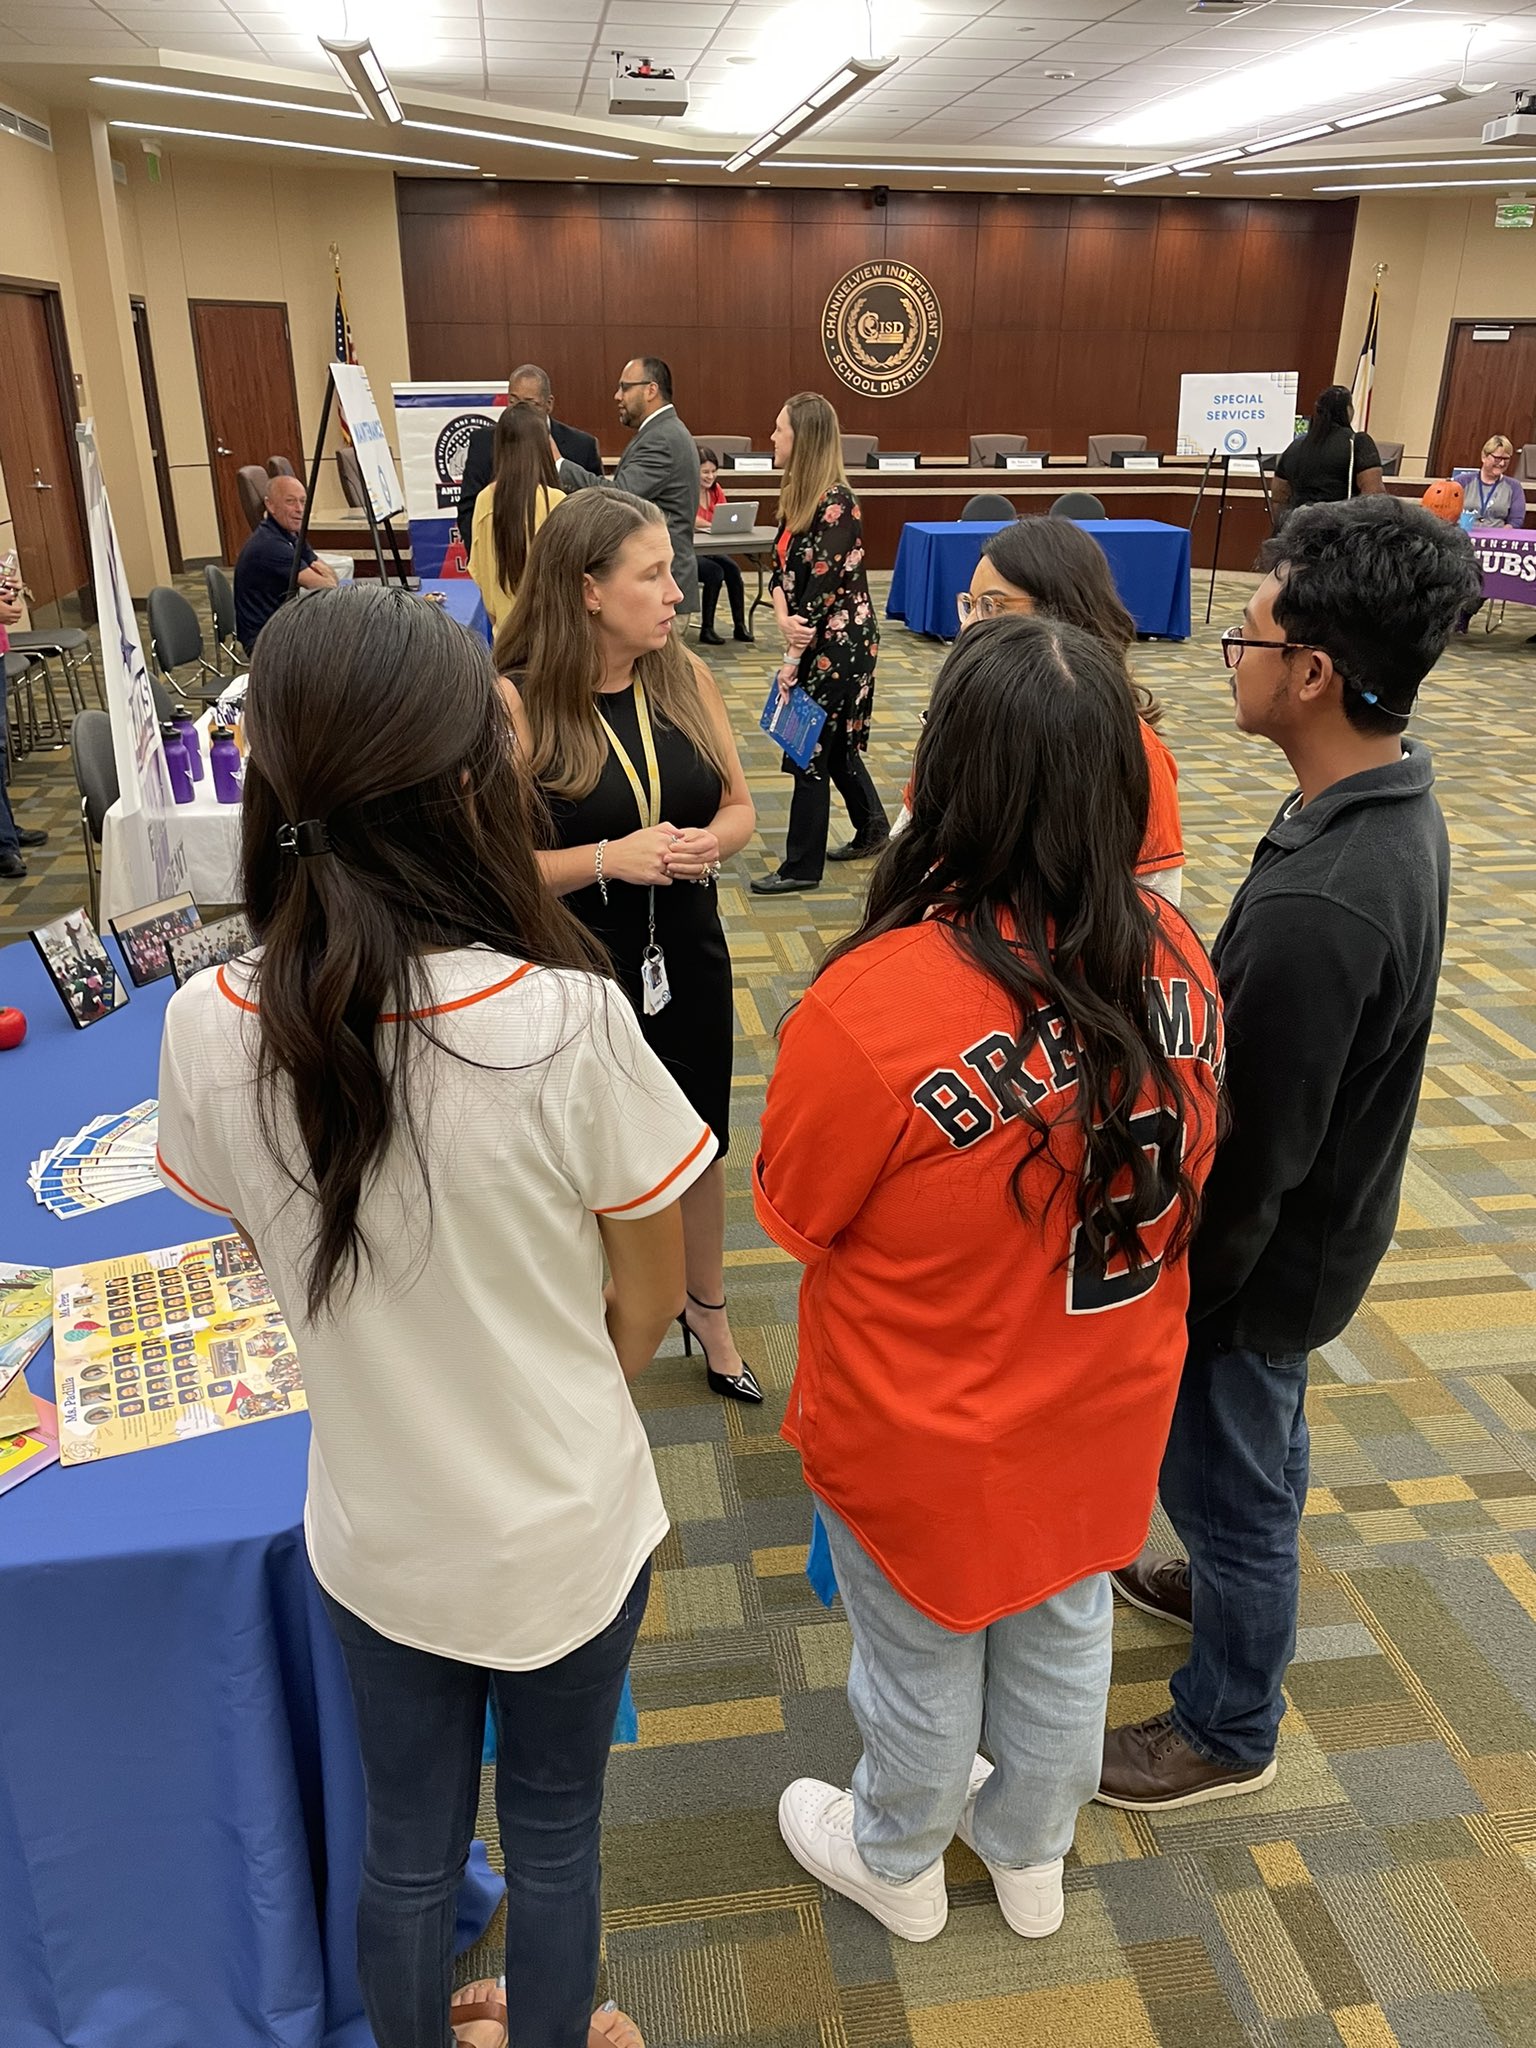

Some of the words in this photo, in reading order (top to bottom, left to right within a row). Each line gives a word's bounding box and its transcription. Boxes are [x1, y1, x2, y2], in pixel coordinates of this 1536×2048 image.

[826, 264, 883, 339] CHANNELVIEW
[886, 264, 938, 338] INDEPENDENT
[832, 354, 878, 393] SCHOOL
[880, 354, 930, 393] DISTRICT
[1206, 409, 1266, 421] SERVICES
[1213, 394, 1264, 405] SPECIAL
[1474, 550, 1536, 582] UBS
[62, 1376, 76, 1407] Padilla
[65, 1406, 77, 1424] Ms.
